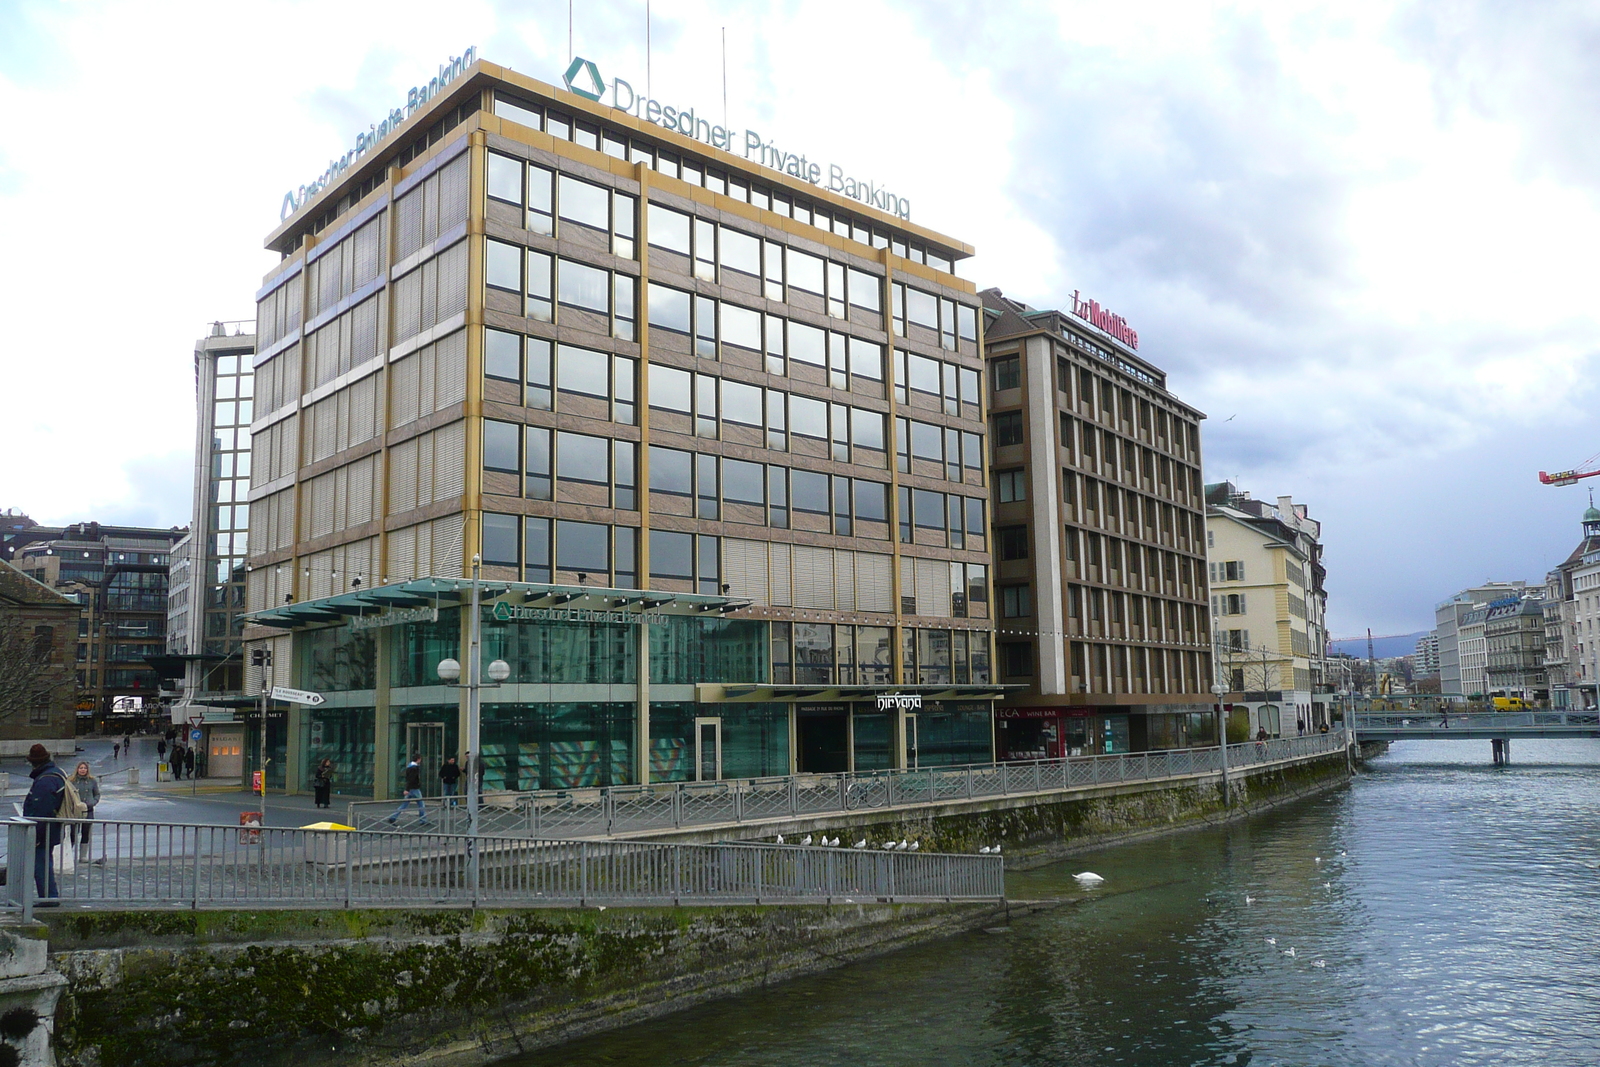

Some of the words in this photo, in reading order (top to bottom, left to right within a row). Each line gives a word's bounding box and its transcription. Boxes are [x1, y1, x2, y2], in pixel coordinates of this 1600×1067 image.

[298, 148, 356, 206] Dresdner
[356, 107, 404, 161] Private
[408, 45, 477, 119] Banking
[612, 77, 735, 151] Dresdner
[744, 129, 820, 184] Private
[828, 163, 910, 221] Banking
[1071, 289, 1089, 320] La
[1089, 299, 1139, 350] Mobilière
[514, 604, 570, 621] Dresdner
[577, 608, 624, 623] Private
[624, 610, 669, 627] Banking
[877, 692, 921, 711] nirvana
